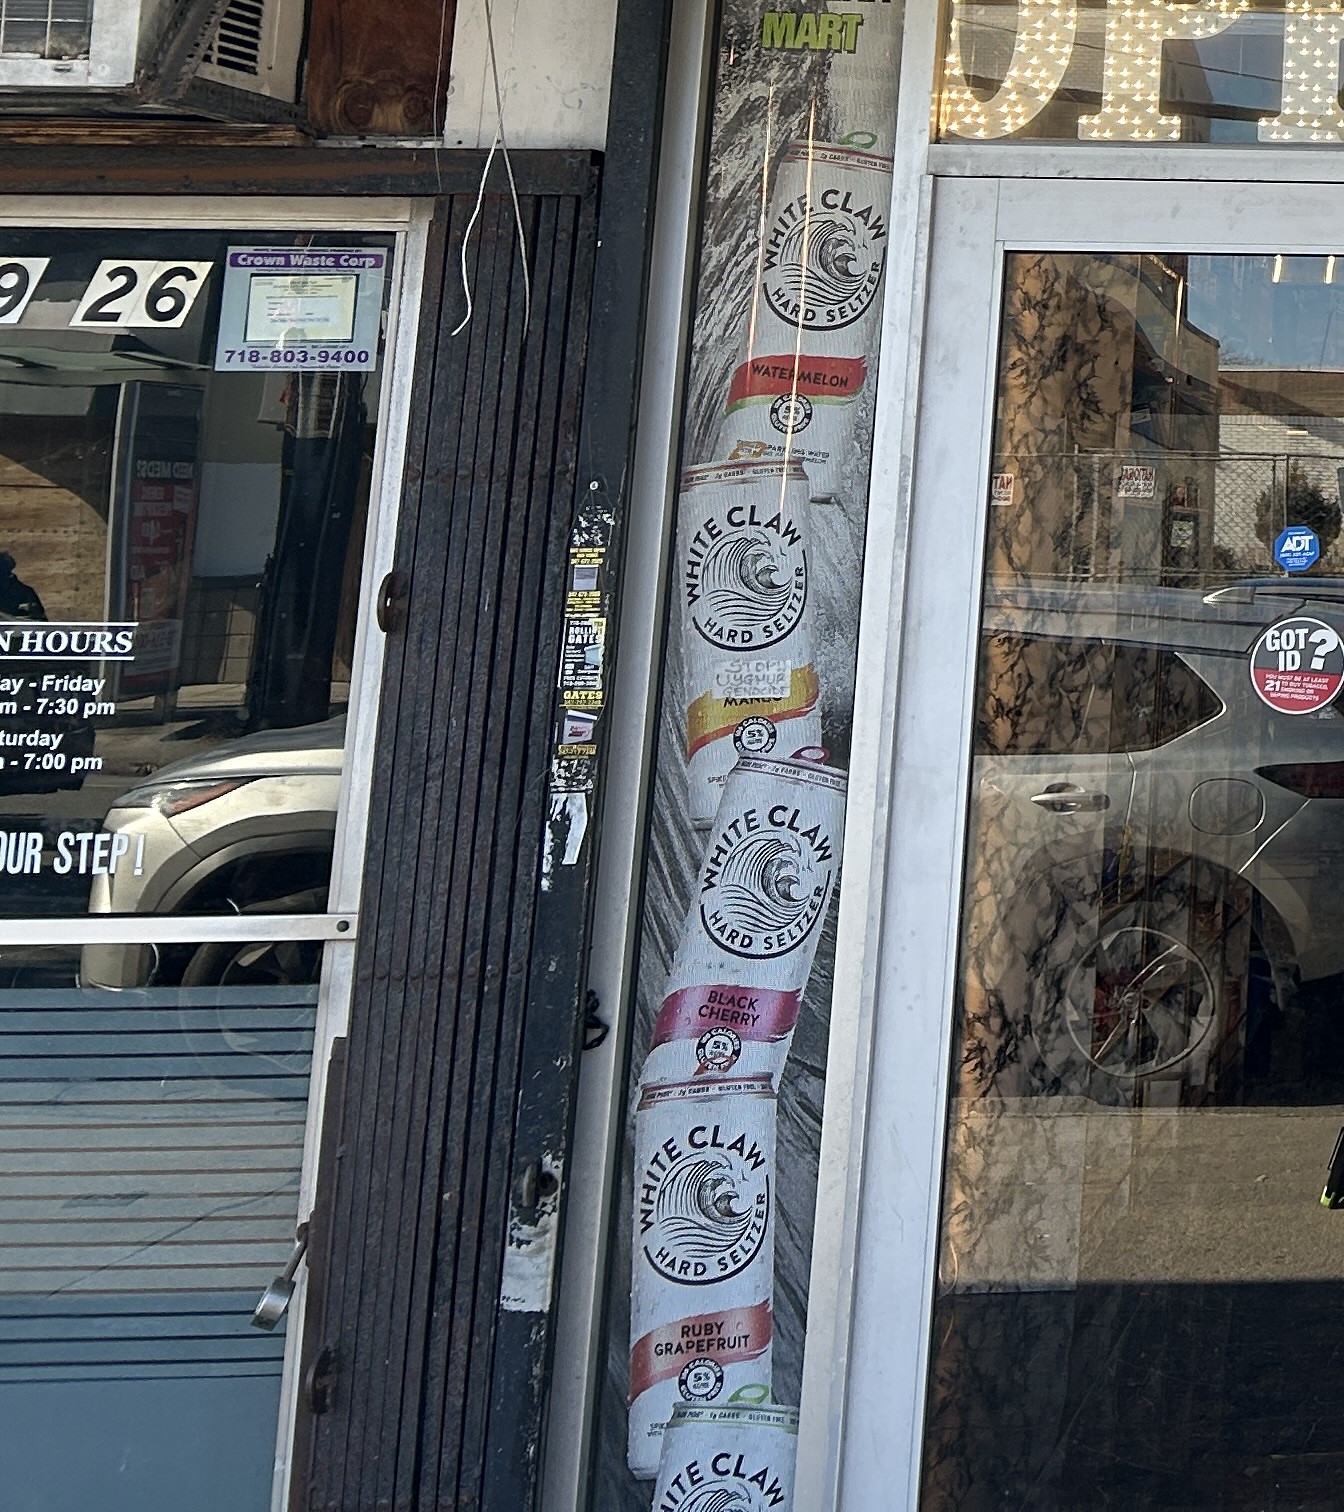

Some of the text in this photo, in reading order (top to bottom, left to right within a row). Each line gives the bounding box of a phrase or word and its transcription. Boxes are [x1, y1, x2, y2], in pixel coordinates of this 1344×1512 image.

[761, 11, 863, 53] MART
[764, 189, 886, 271] WHITE CLAW
[237, 254, 376, 268] Crown Waste Corp
[81, 266, 198, 322] 26
[771, 261, 881, 323] HARD SELTZER
[224, 349, 370, 364] 718-803-9400
[752, 364, 849, 388] WATERMELON
[1281, 535, 1314, 552] ADT
[685, 505, 801, 607] WHITE CLAW
[704, 566, 805, 644] HARD SELTZER
[20, 630, 133, 653] HOURS
[1265, 628, 1310, 651] GOT
[1278, 650, 1301, 672] ID
[42, 675, 106, 696] Friday
[716, 673, 786, 687] UYGHUR
[1264, 680, 1280, 692] 21
[36, 699, 79, 715] 7:30
[84, 701, 115, 718] pm
[24, 754, 65, 770] 7:00
[71, 755, 103, 773] pm
[701, 805, 833, 891] WHITE CLAW
[709, 885, 824, 951] HARD SELTZER
[707, 990, 758, 1012] BLACK
[698, 1004, 760, 1028] CHERRY
[639, 1125, 766, 1235] WHITE CLAW
[655, 1192, 765, 1277] HARD SELTZER
[681, 1321, 724, 1339] RUBY
[654, 1334, 750, 1357] GRAPEFRUIT
[711, 1452, 785, 1507] CLAW
